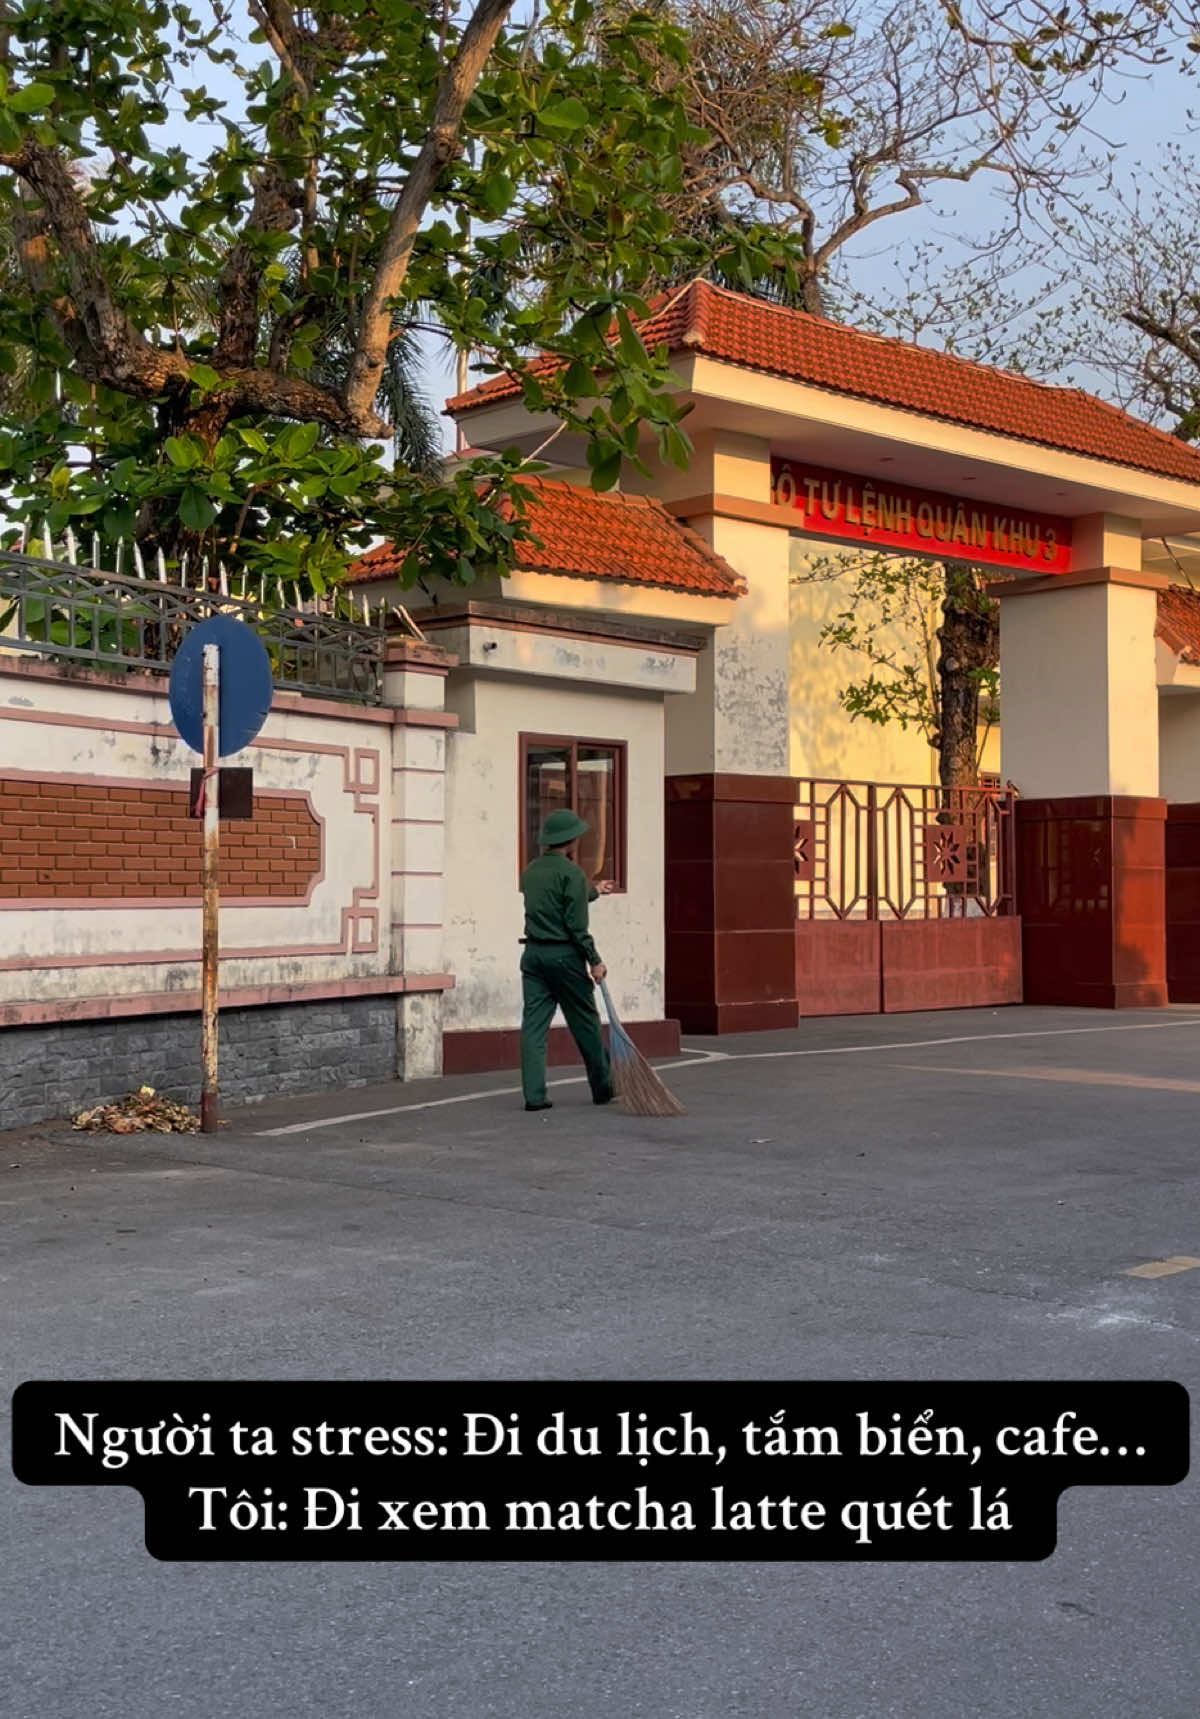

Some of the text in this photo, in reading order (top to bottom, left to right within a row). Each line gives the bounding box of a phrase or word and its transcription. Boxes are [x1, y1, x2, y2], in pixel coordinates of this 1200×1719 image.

[803, 477, 842, 521] TƯ
[843, 481, 912, 537] LỆNH
[915, 501, 987, 549] QUÂN
[991, 515, 1040, 559] KHU
[1042, 527, 1057, 562] 3
